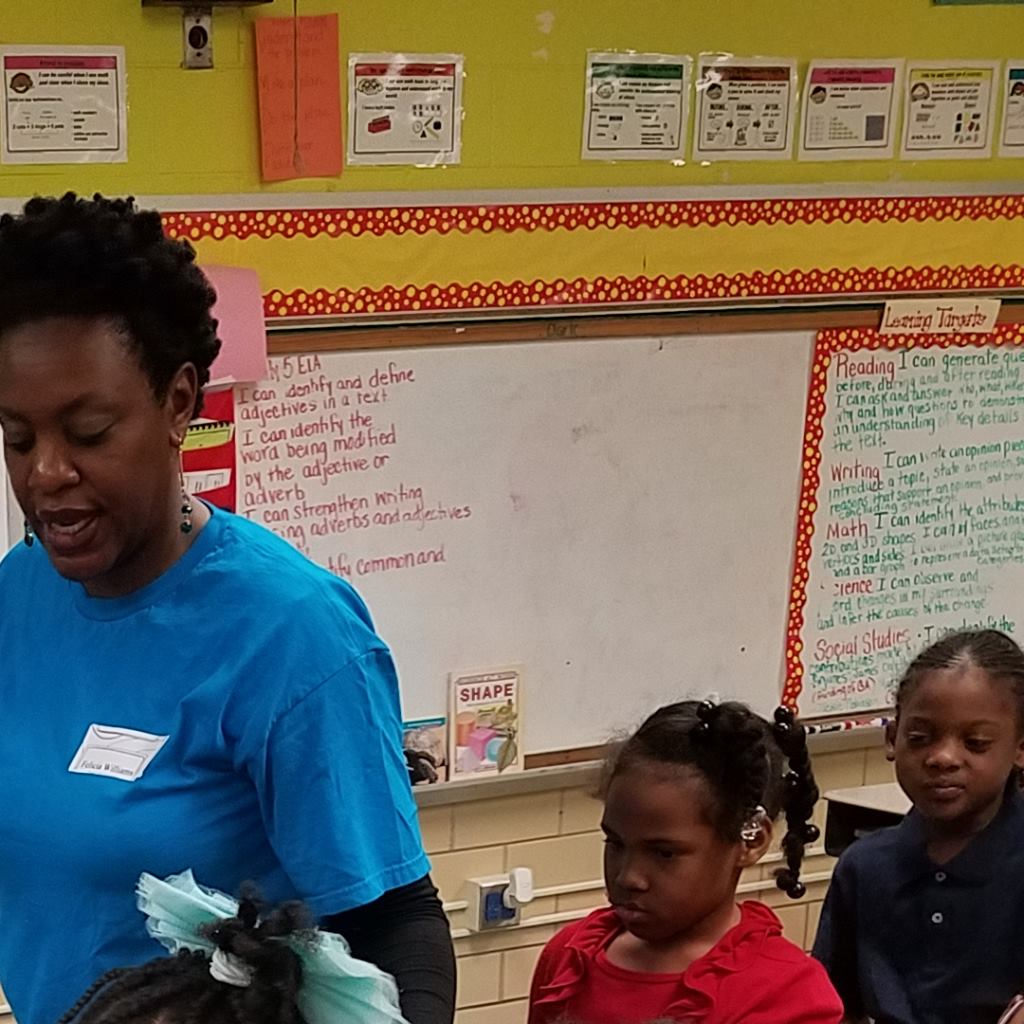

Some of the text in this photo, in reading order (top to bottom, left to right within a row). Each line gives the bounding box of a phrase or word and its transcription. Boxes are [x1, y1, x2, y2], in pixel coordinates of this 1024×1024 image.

[833, 352, 895, 381] Reading
[898, 350, 908, 369] I
[912, 355, 936, 368] can
[942, 348, 998, 374] generate
[238, 387, 249, 405] I
[252, 388, 277, 402] can
[336, 374, 363, 390] and
[369, 361, 416, 388] define
[240, 401, 318, 428] adjectives
[322, 396, 337, 410] in
[242, 409, 373, 446] I can identify the
[286, 440, 328, 466] being
[333, 422, 397, 452] modified
[267, 463, 295, 482] the
[302, 456, 370, 486] adjective
[373, 454, 390, 469] or
[831, 458, 880, 483] Writing
[883, 450, 896, 469] I
[897, 453, 918, 468] can
[244, 482, 305, 507] adverb
[263, 508, 290, 524] can
[293, 494, 369, 521] strengthen
[375, 483, 425, 513] writing
[310, 510, 370, 537] adverbs
[372, 507, 401, 526] and
[402, 502, 473, 532] adjectives
[826, 516, 869, 541] Math
[874, 511, 889, 530] I
[891, 515, 911, 528] can
[915, 502, 954, 525] identify
[356, 552, 415, 576] common
[417, 544, 447, 564] and
[878, 578, 886, 592] I
[890, 577, 912, 590] can
[814, 635, 858, 662] Social
[862, 627, 912, 656] Studies
[460, 683, 514, 702] SHAPE
